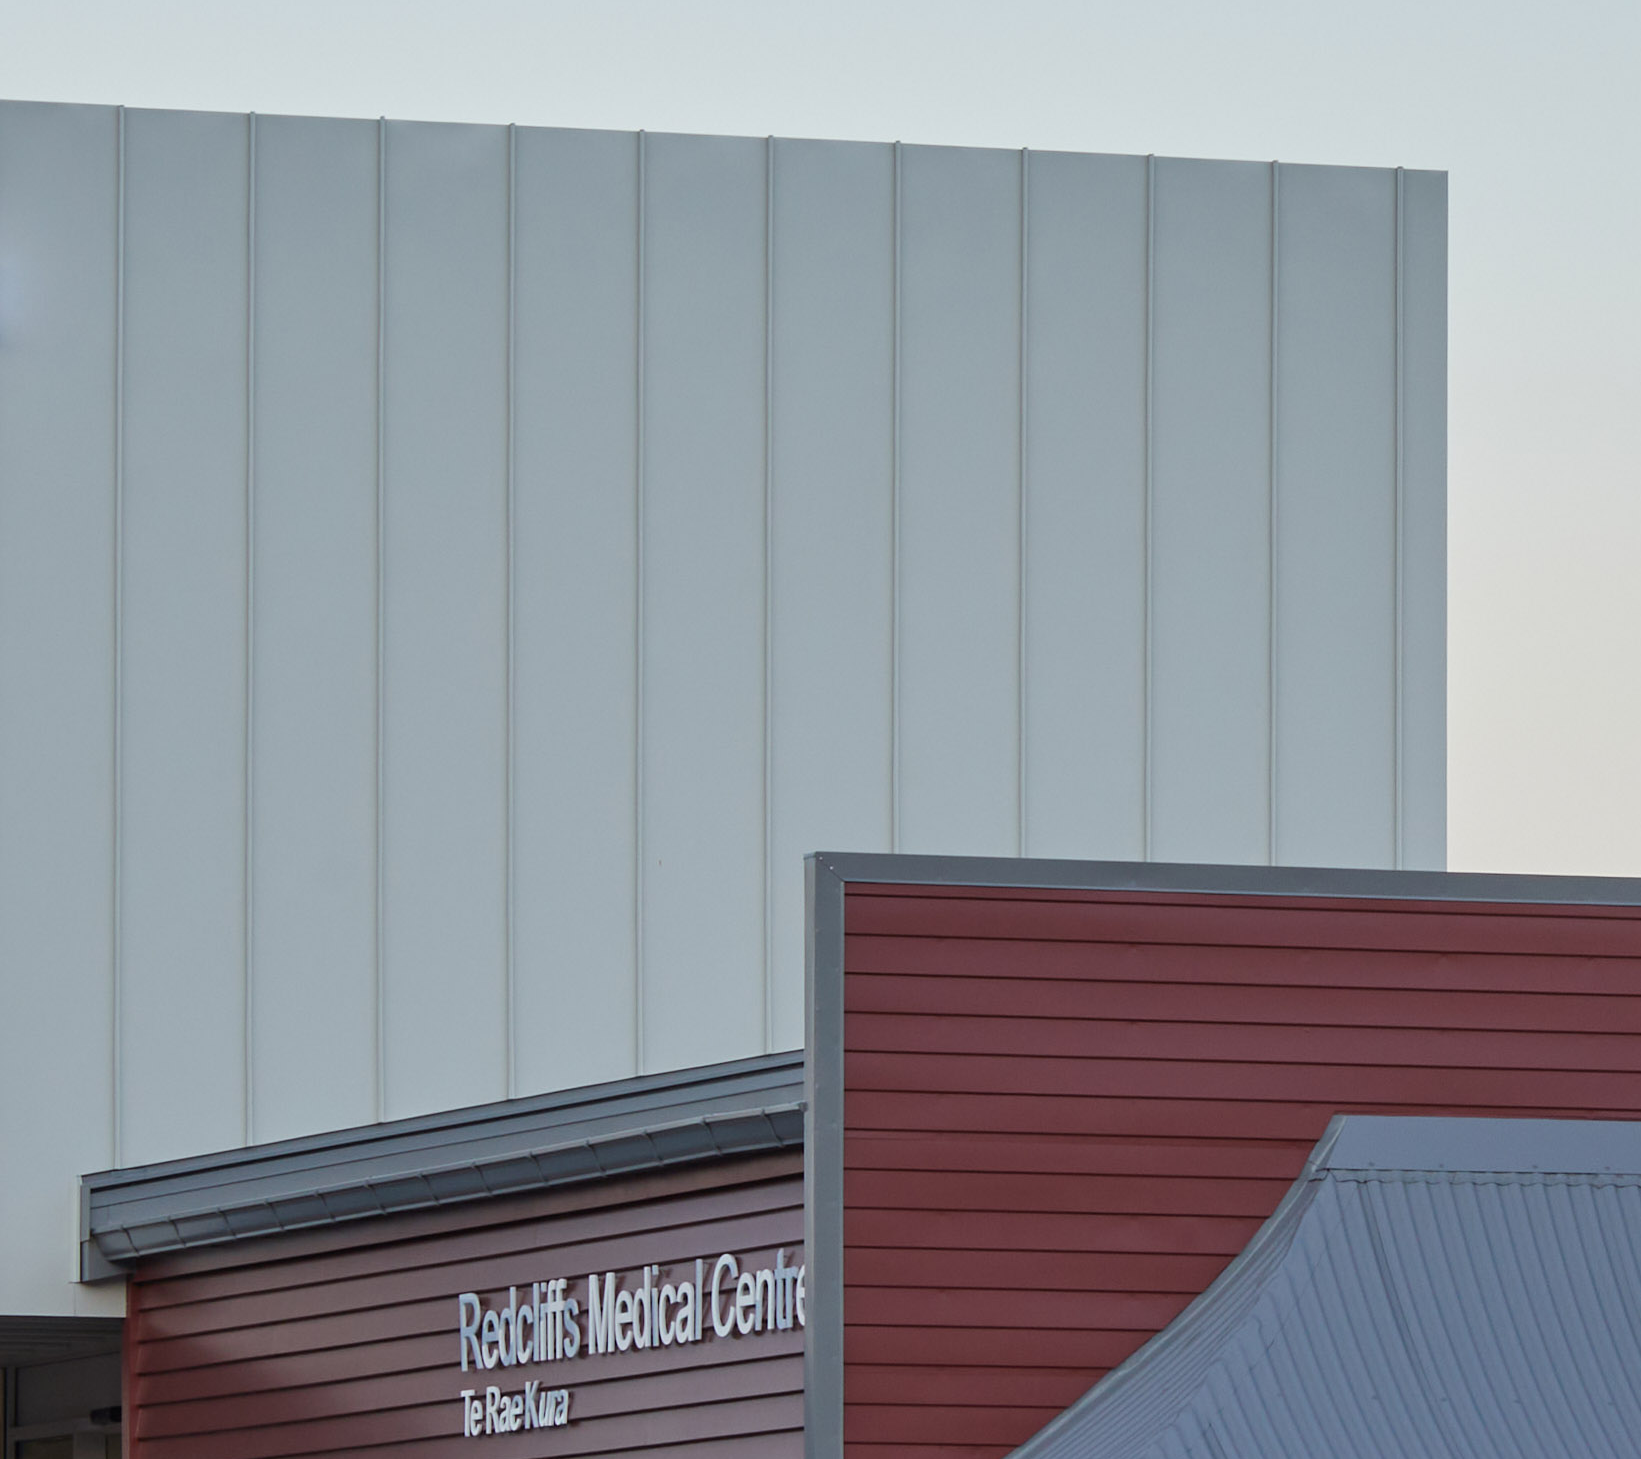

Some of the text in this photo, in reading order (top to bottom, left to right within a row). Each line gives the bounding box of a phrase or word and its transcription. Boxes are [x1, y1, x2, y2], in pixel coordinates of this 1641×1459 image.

[459, 1278, 581, 1372] Redcliffs
[588, 1259, 703, 1355] Medical
[461, 1380, 569, 1437] Te Rae Kura
